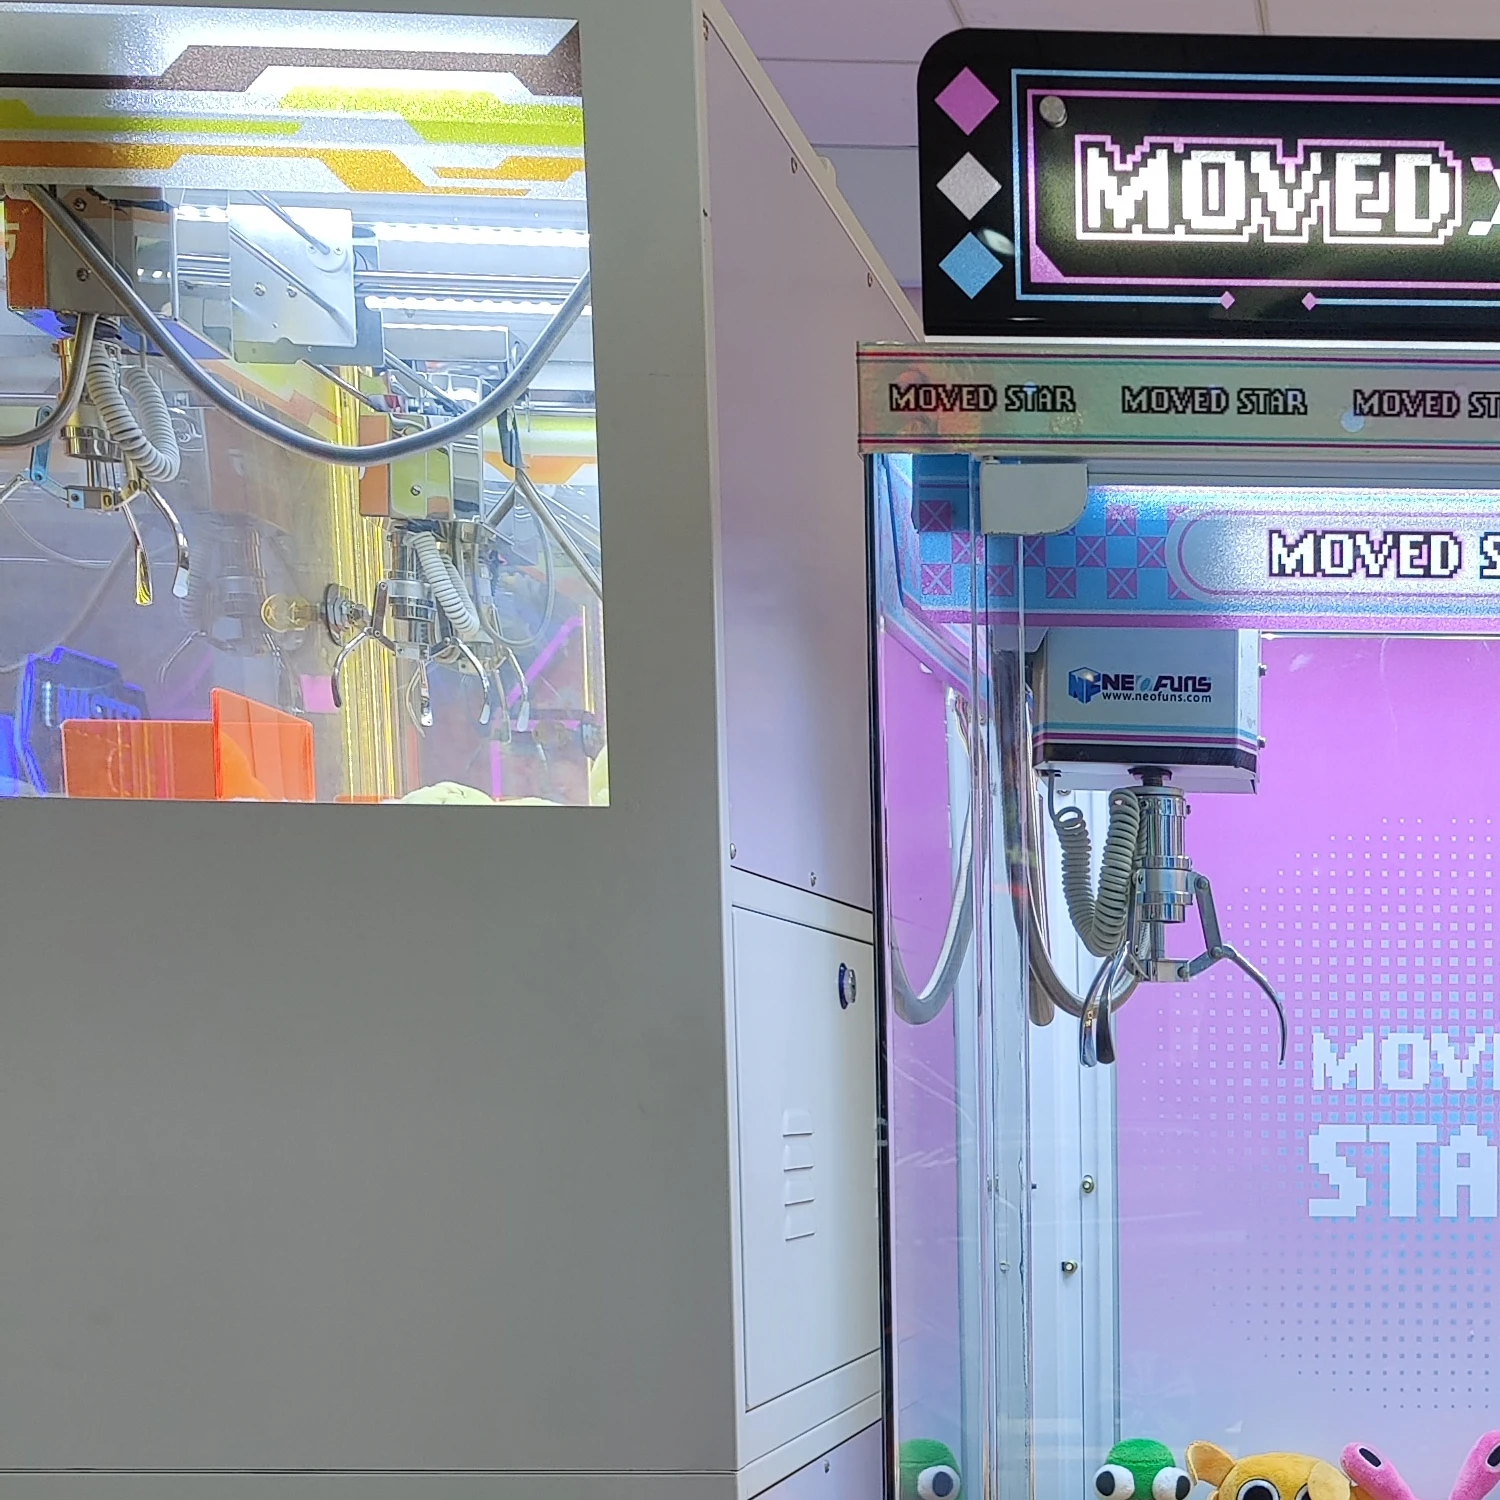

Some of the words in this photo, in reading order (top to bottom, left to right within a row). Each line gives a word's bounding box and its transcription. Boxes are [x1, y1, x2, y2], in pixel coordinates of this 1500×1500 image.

[1075, 136, 1462, 241] MOVED
[890, 383, 996, 412] MOVED
[1005, 384, 1076, 412] STAR
[1122, 385, 1229, 414] MOVED
[1237, 387, 1307, 415] STAR
[1353, 389, 1460, 417] MOVED
[1268, 530, 1462, 578] MOVED
[1102, 690, 1212, 703] www.neofuns.com
